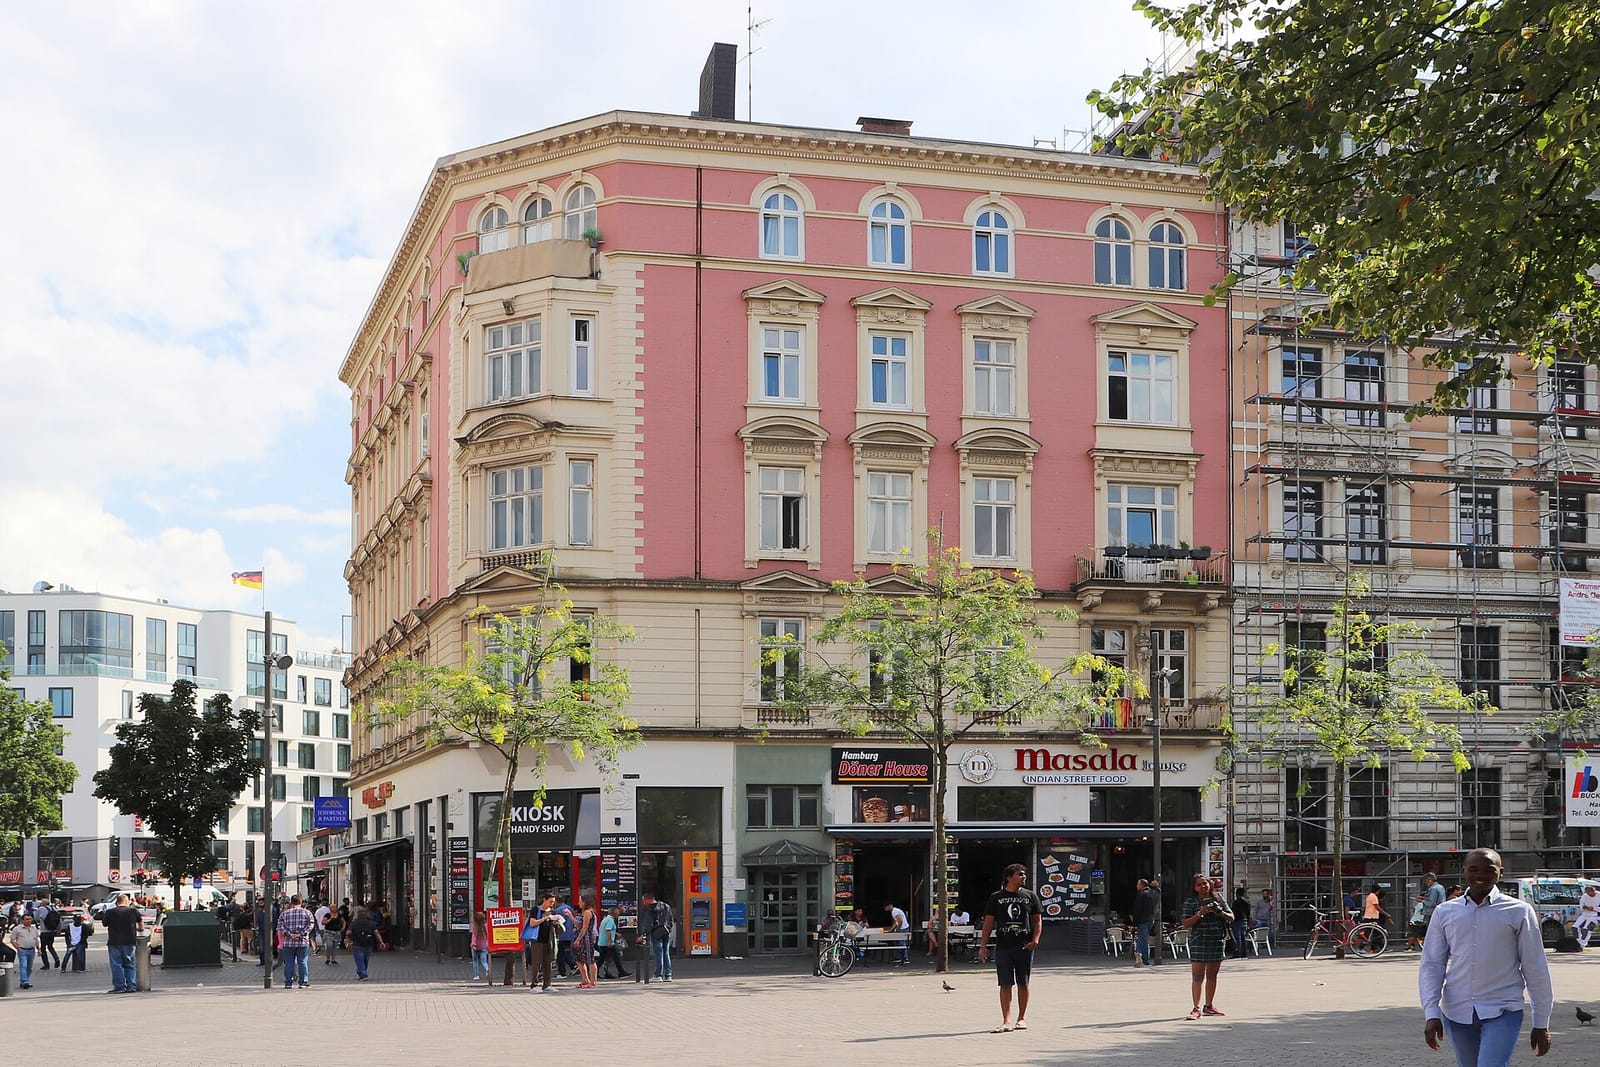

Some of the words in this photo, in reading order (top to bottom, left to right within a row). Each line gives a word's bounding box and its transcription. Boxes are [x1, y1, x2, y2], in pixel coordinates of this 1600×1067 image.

[842, 751, 879, 761] Hamburg
[839, 760, 883, 776] Döner
[884, 761, 929, 776] House
[1026, 775, 1061, 783] INDIAN
[1063, 775, 1097, 783] STREET
[1100, 775, 1127, 783] FOOD
[511, 805, 565, 821] KIOSK
[511, 824, 540, 833] HANDY
[541, 824, 565, 833] SHOP
